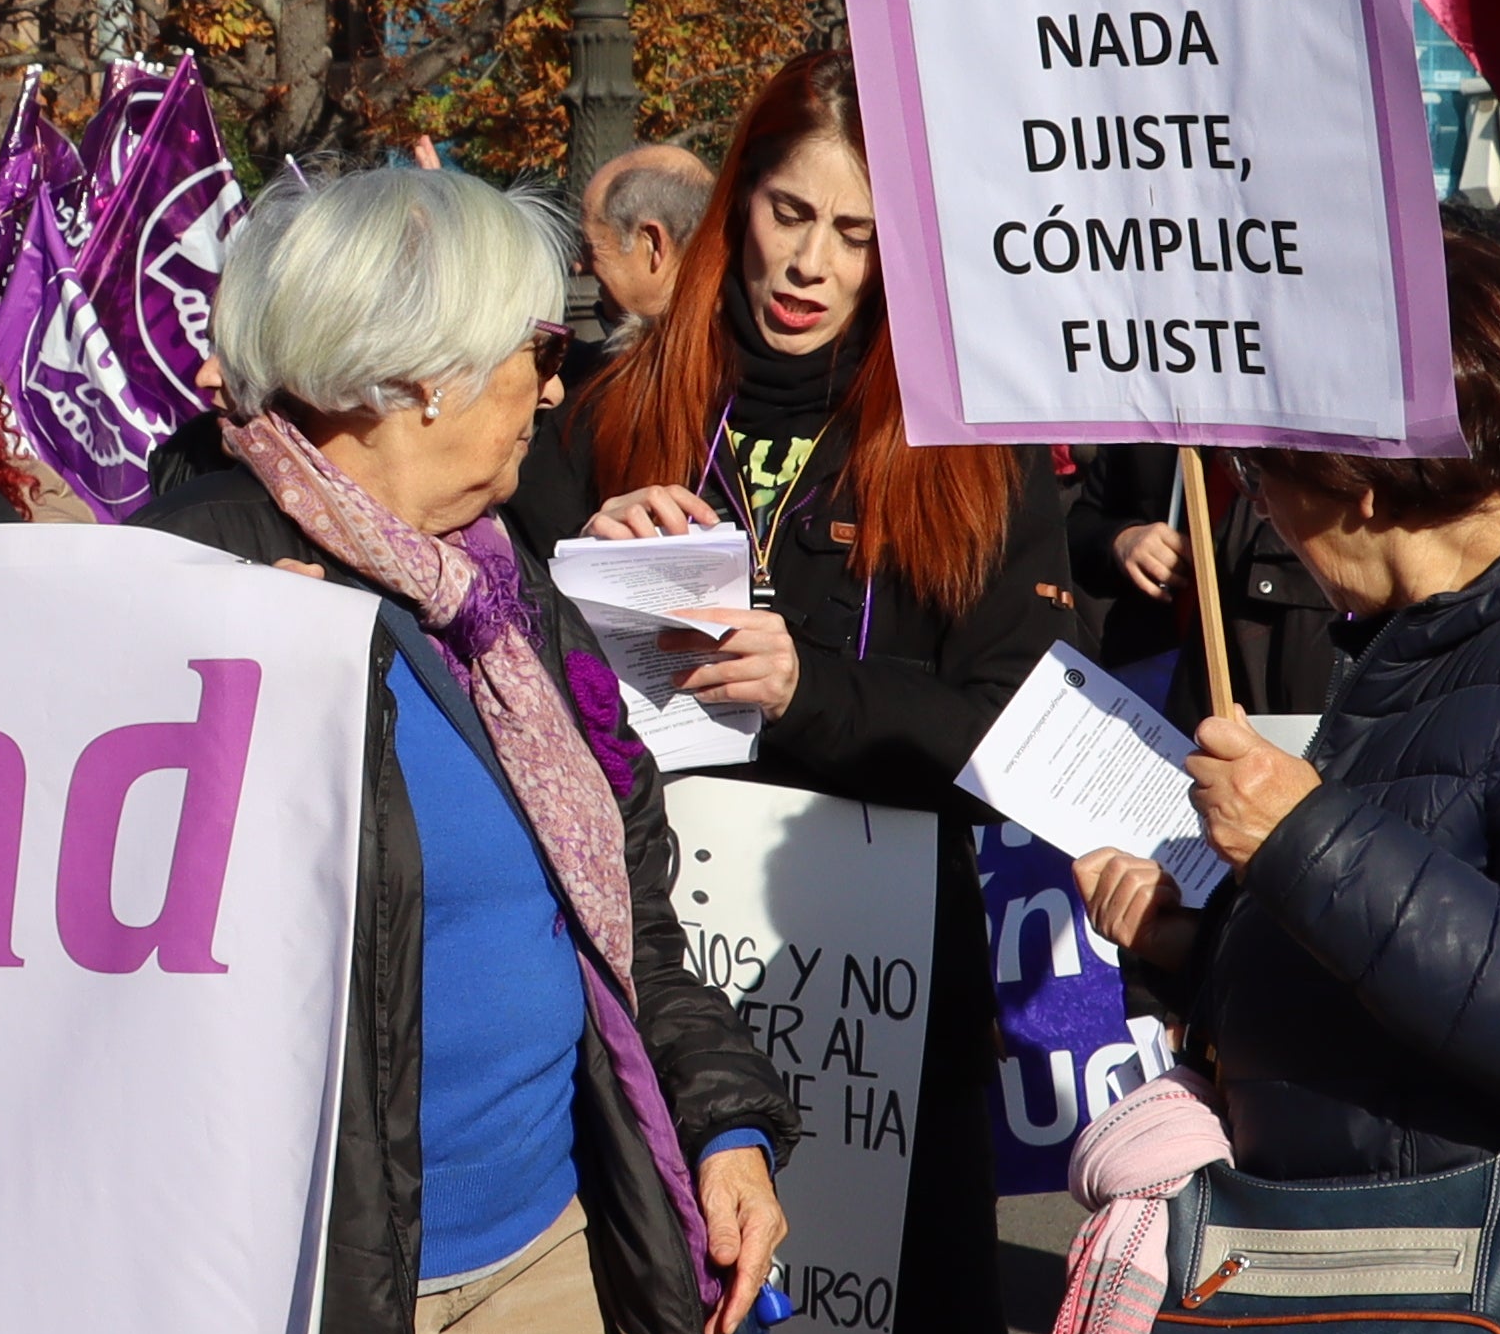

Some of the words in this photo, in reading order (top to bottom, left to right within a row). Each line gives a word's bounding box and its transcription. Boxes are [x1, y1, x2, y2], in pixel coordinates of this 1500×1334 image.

[1037, 10, 1219, 70] NADA
[1022, 115, 1252, 183] DIJISTE,
[992, 204, 1304, 276] CÓMPLICE
[1061, 318, 1267, 376] FUISTE
[788, 943, 822, 1001] Y
[840, 953, 918, 1021] NO
[821, 1016, 879, 1079] AL
[844, 1083, 907, 1158] HA
